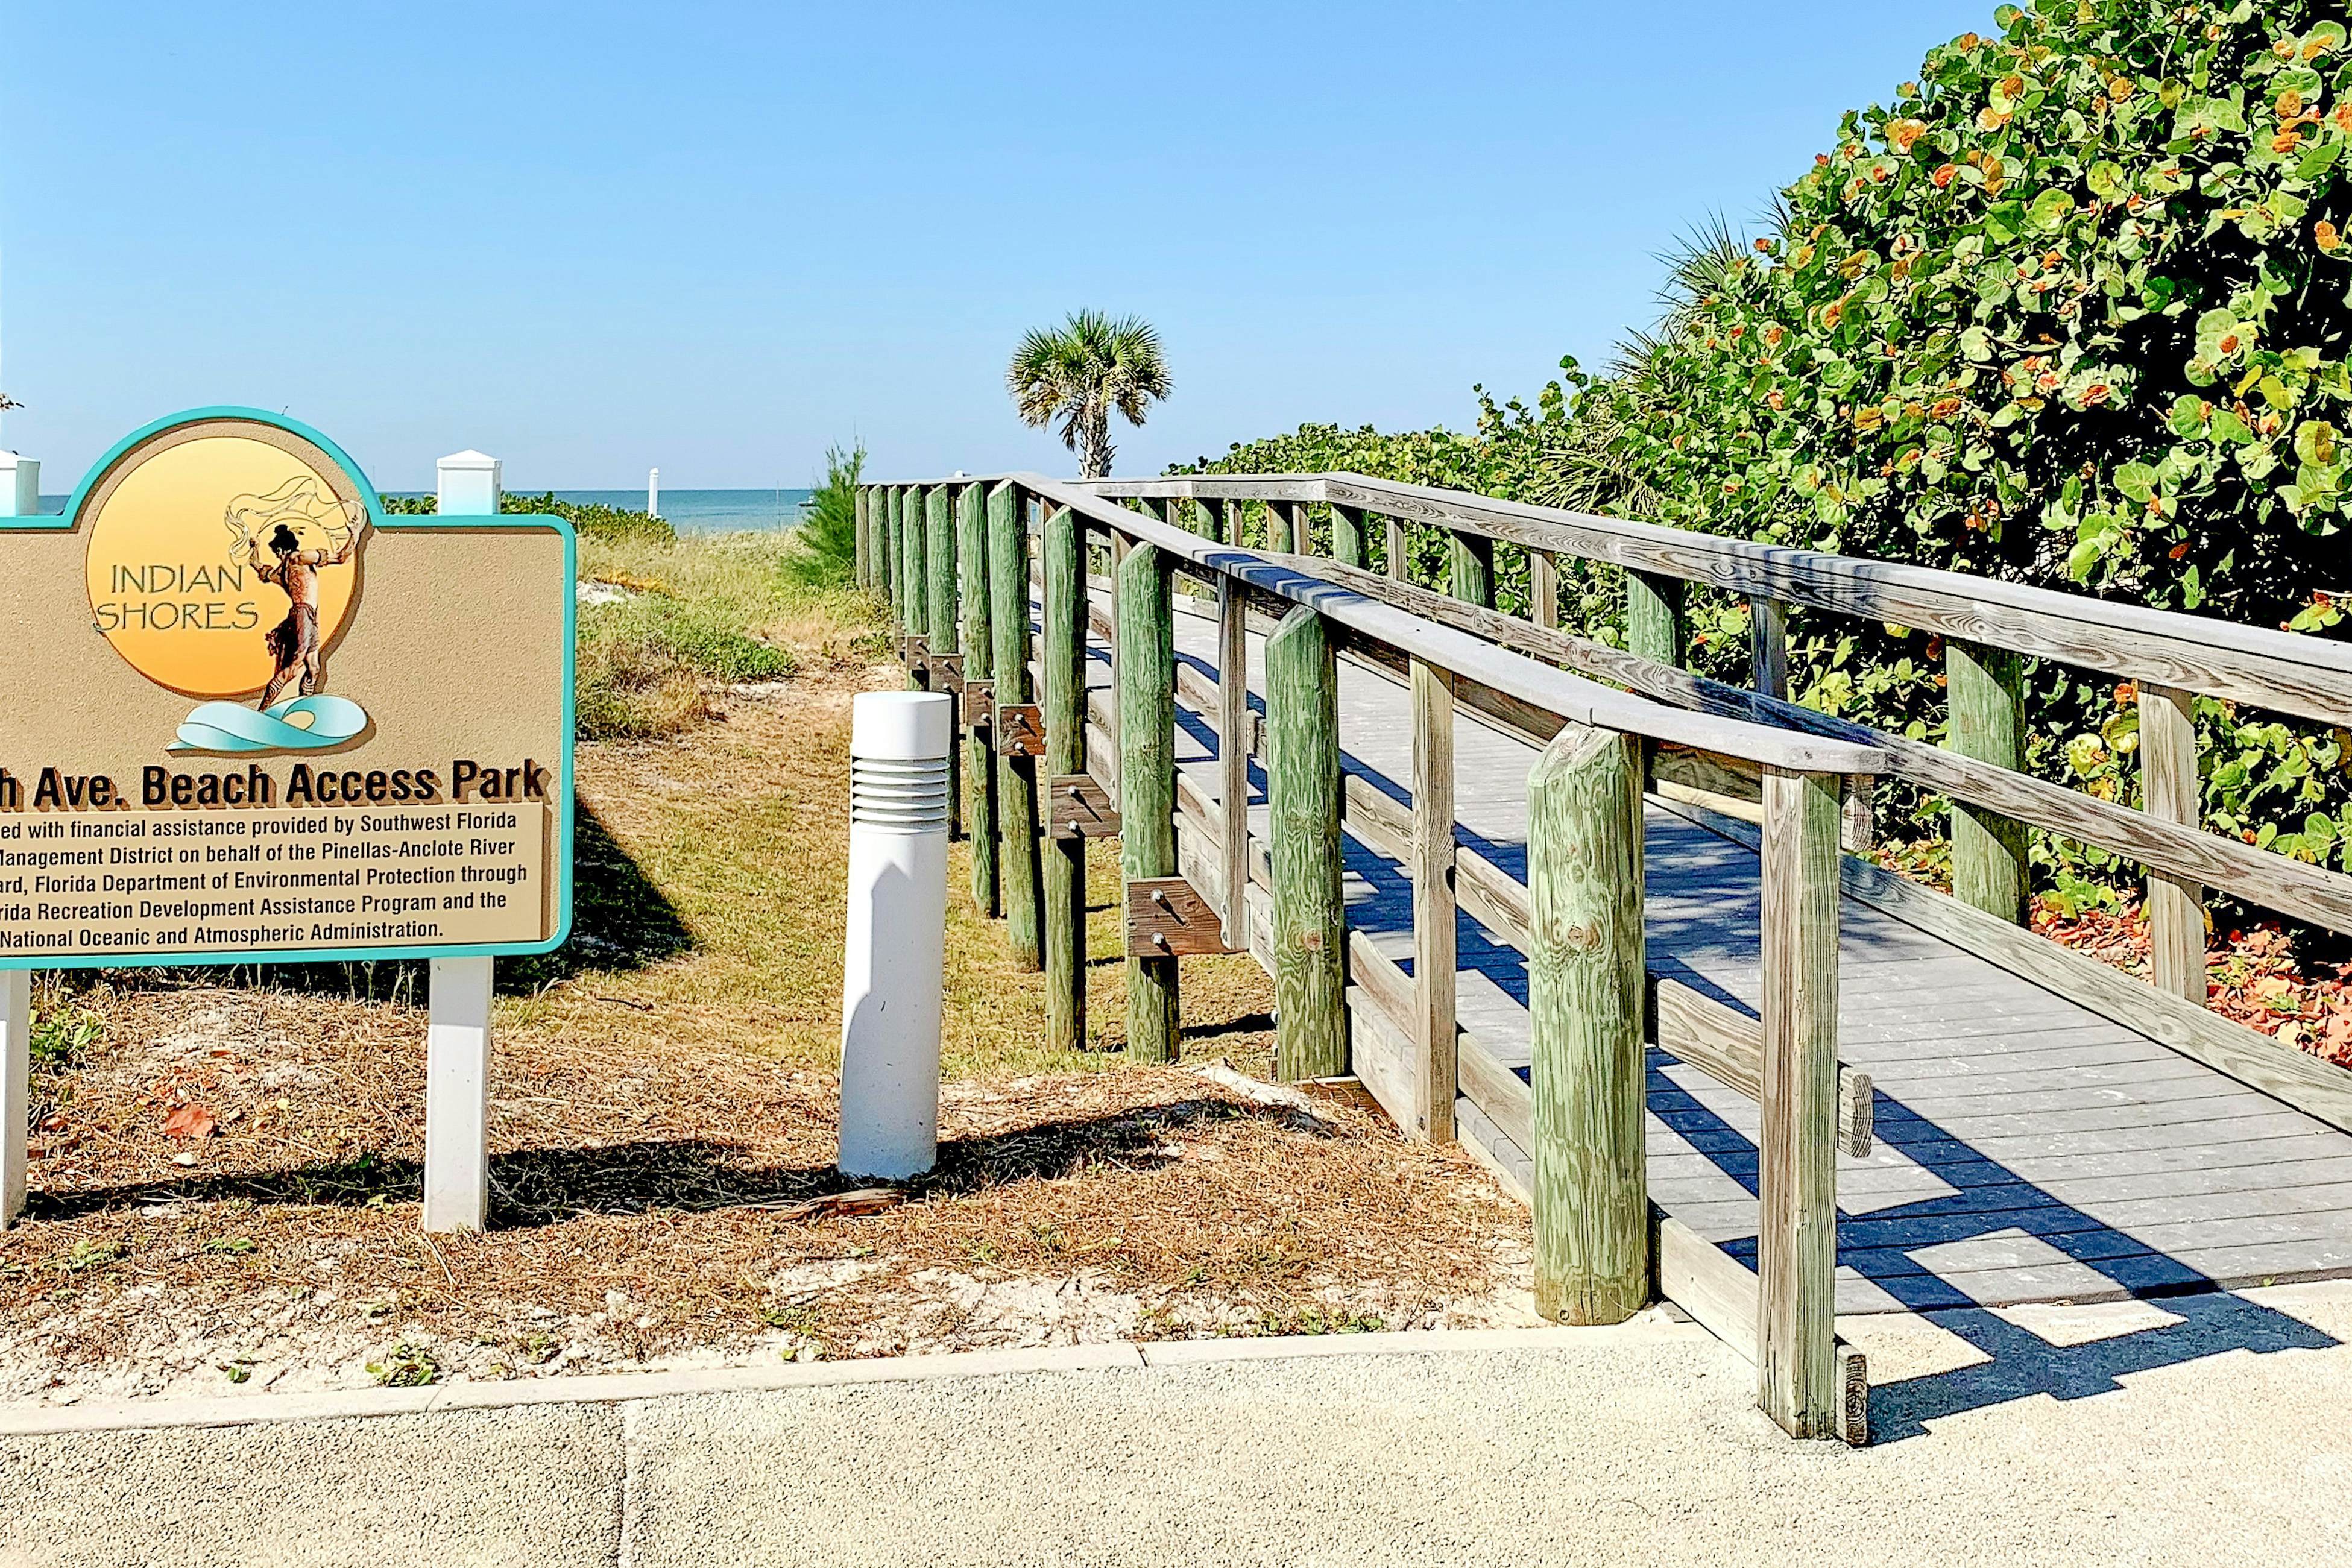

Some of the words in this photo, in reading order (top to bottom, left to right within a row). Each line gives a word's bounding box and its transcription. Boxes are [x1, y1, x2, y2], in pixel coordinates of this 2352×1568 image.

[111, 564, 242, 594] INDIAN
[93, 602, 259, 631] SHORES
[33, 767, 124, 807] Ave.
[142, 764, 269, 805] Beach
[286, 763, 435, 802] Access
[452, 758, 546, 798] Park
[1, 822, 20, 839] ed
[28, 822, 63, 838] with
[71, 820, 145, 837] financial
[153, 819, 245, 836] assistance
[253, 817, 327, 836] provided
[335, 816, 354, 834] by
[361, 814, 450, 831] Southwest
[458, 812, 516, 829] Florida
[0, 849, 103, 869] anagement
[110, 847, 172, 864] District
[180, 850, 199, 863] on
[207, 845, 260, 862] behalf
[266, 844, 282, 860] of
[289, 844, 315, 860] the
[323, 840, 463, 859] Pinellas-Anclote
[471, 839, 515, 855] River
[36, 875, 95, 892] Florida
[104, 874, 206, 895] Department
[212, 872, 228, 889] of
[235, 869, 359, 888] Environmental
[367, 867, 454, 885] Protection
[461, 864, 526, 884] through
[38, 902, 132, 919] Recreation
[140, 899, 254, 919] Development
[260, 898, 355, 915] Assistance
[362, 896, 435, 915] Program
[443, 892, 473, 909] and
[481, 892, 506, 908] the
[1, 930, 72, 948] National
[80, 928, 149, 946] Oceanic
[157, 927, 187, 944] and
[194, 925, 304, 946] Atmospheric
[311, 921, 443, 940] Administration.
